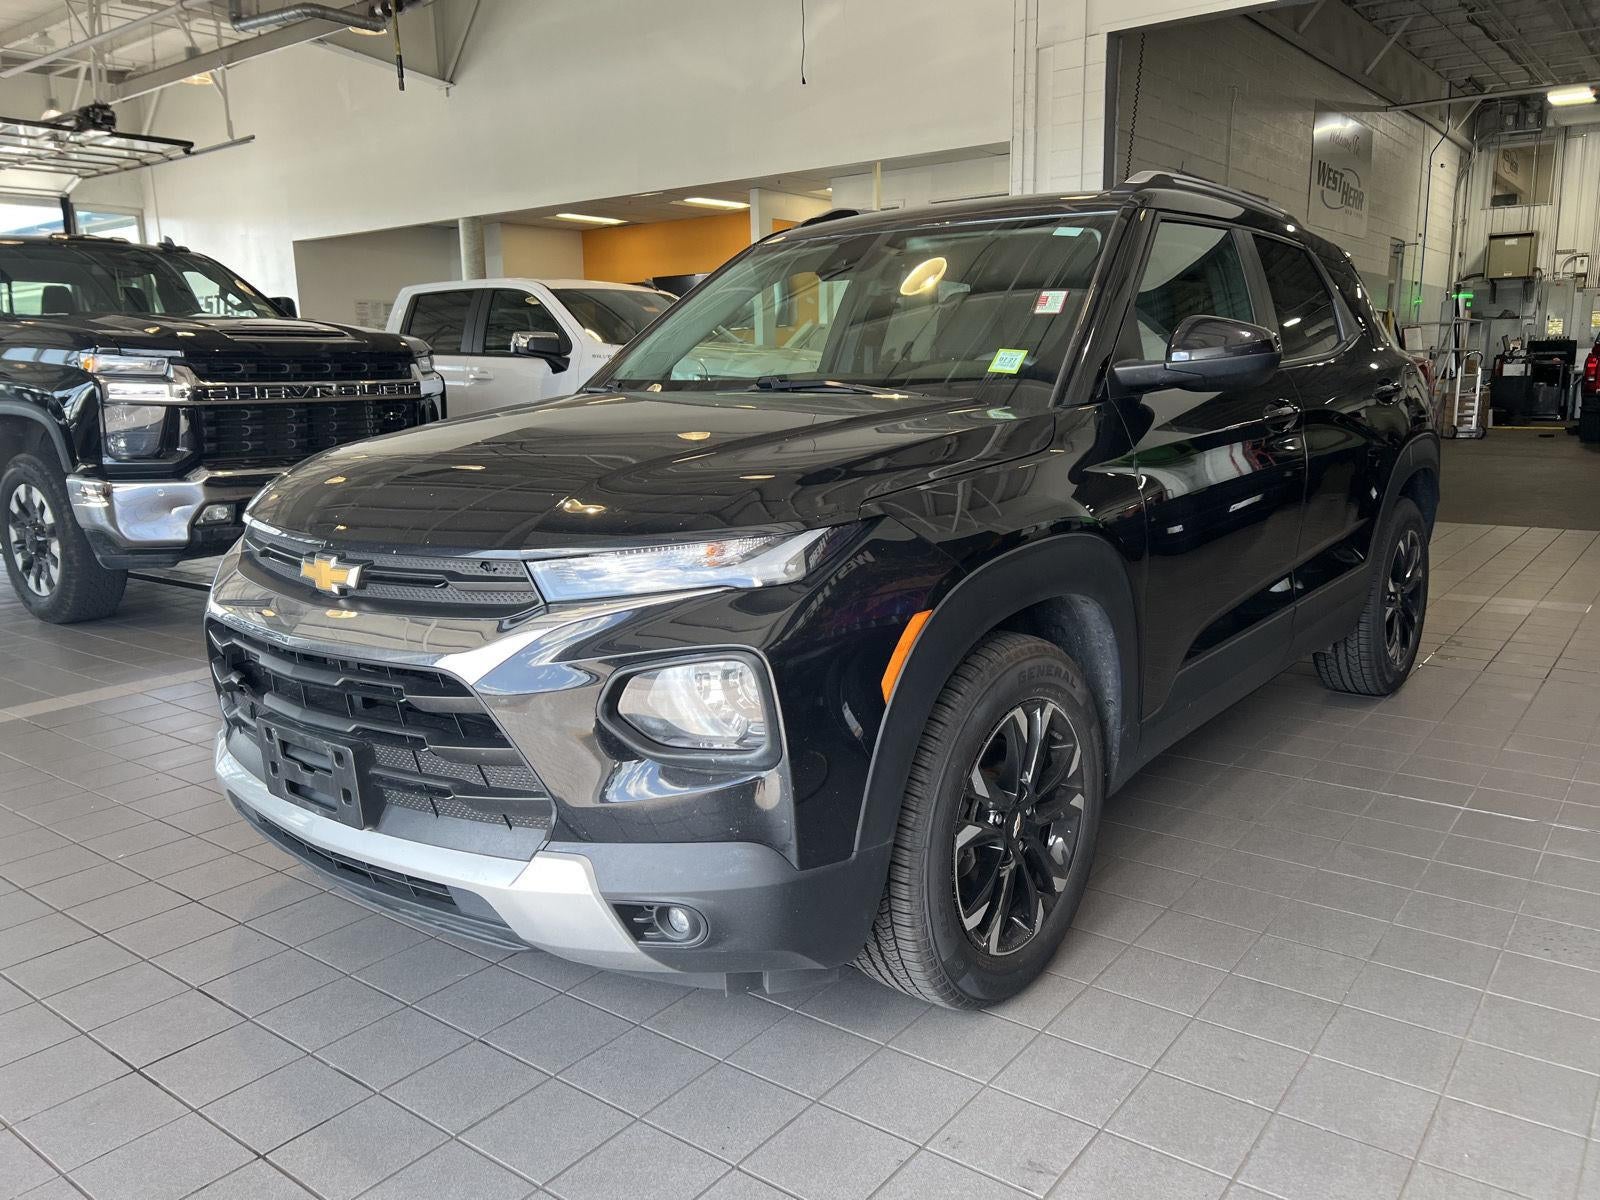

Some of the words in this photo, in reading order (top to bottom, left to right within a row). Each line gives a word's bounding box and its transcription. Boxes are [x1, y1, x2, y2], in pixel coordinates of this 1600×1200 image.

[1317, 160, 1345, 193] WEST
[1341, 181, 1364, 211] HERR
[205, 381, 417, 400] CHEVROLET
[1018, 664, 1077, 689] GENERAL
